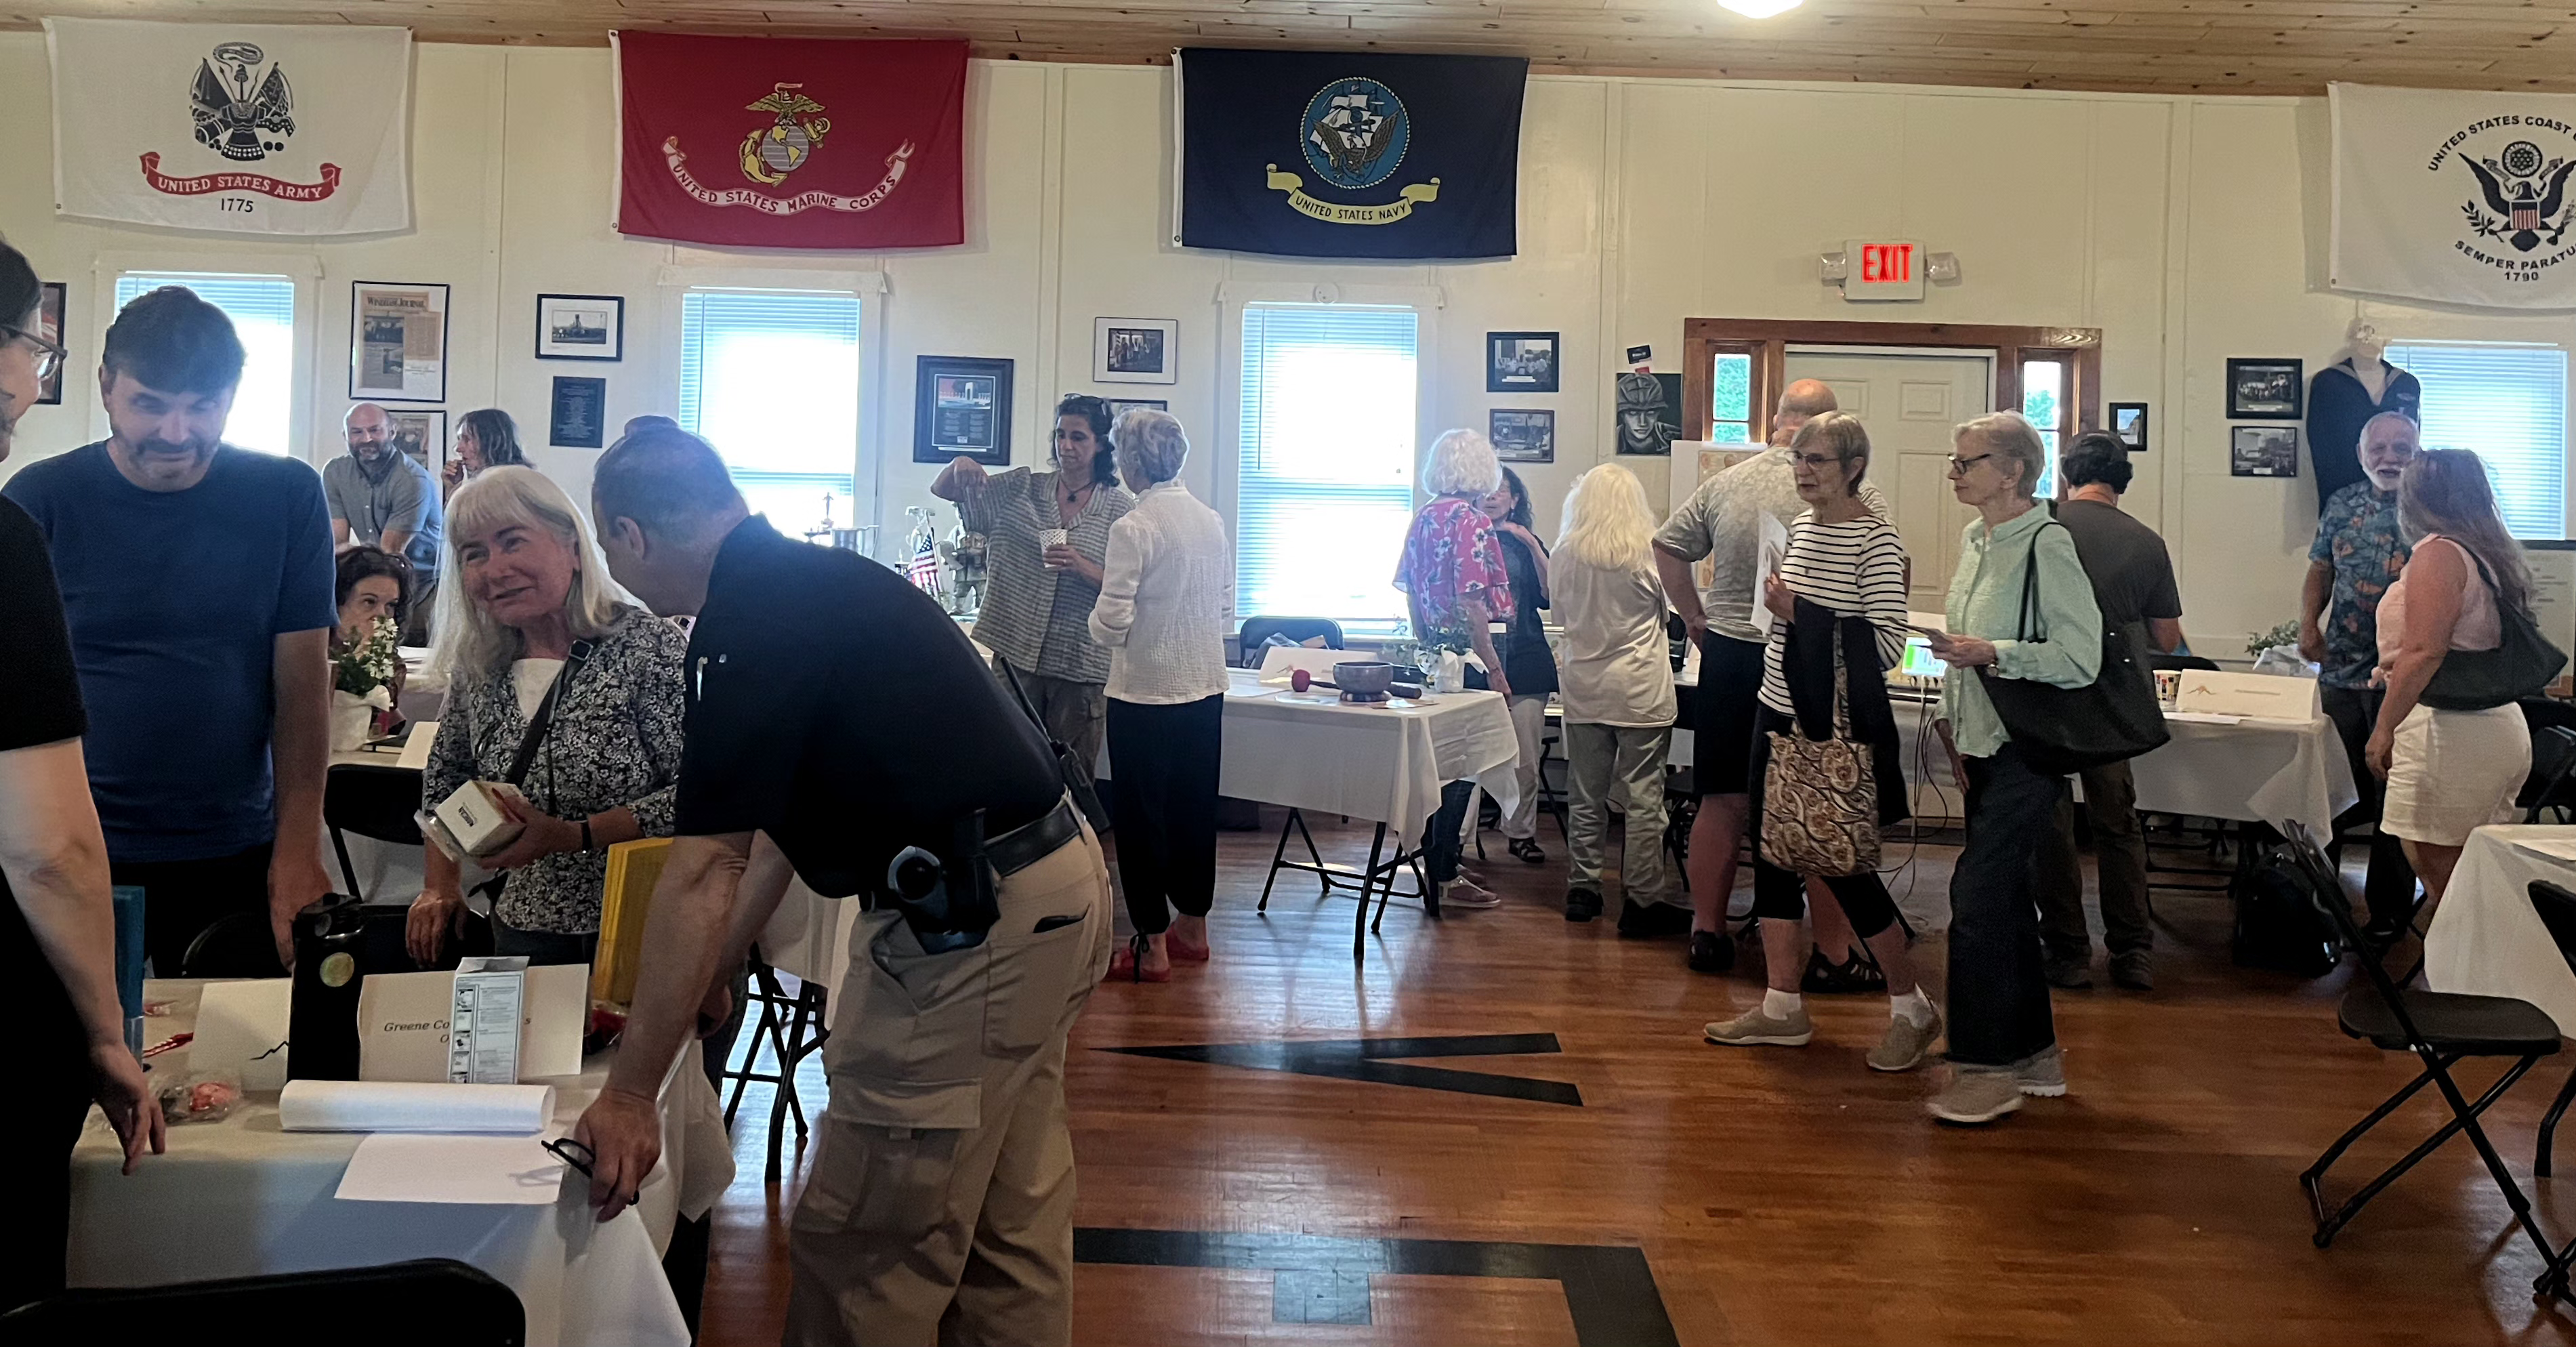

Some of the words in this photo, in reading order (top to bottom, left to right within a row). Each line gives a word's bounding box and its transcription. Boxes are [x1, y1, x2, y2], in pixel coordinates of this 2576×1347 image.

[2428, 131, 2466, 171] UNITED
[2468, 115, 2520, 134] STATES
[2525, 116, 2572, 134] COAST
[158, 177, 210, 192] UNITED
[217, 176, 270, 191] STATES
[274, 185, 322, 199] ARMY
[673, 163, 718, 203] UNITED
[726, 192, 778, 212] STATES
[787, 192, 837, 213] MARINE
[850, 175, 896, 209] CORPS
[221, 198, 253, 213] 1775
[1295, 195, 1331, 217] UNITED
[1337, 209, 1373, 220] STATES
[1379, 204, 1406, 220] NAVY
[1862, 244, 1913, 283] EXIT
[2455, 240, 2514, 270] SEMPER
[2521, 243, 2576, 270] PARATU
[2504, 272, 2539, 282] 1790
[384, 1022, 429, 1032] Greene
